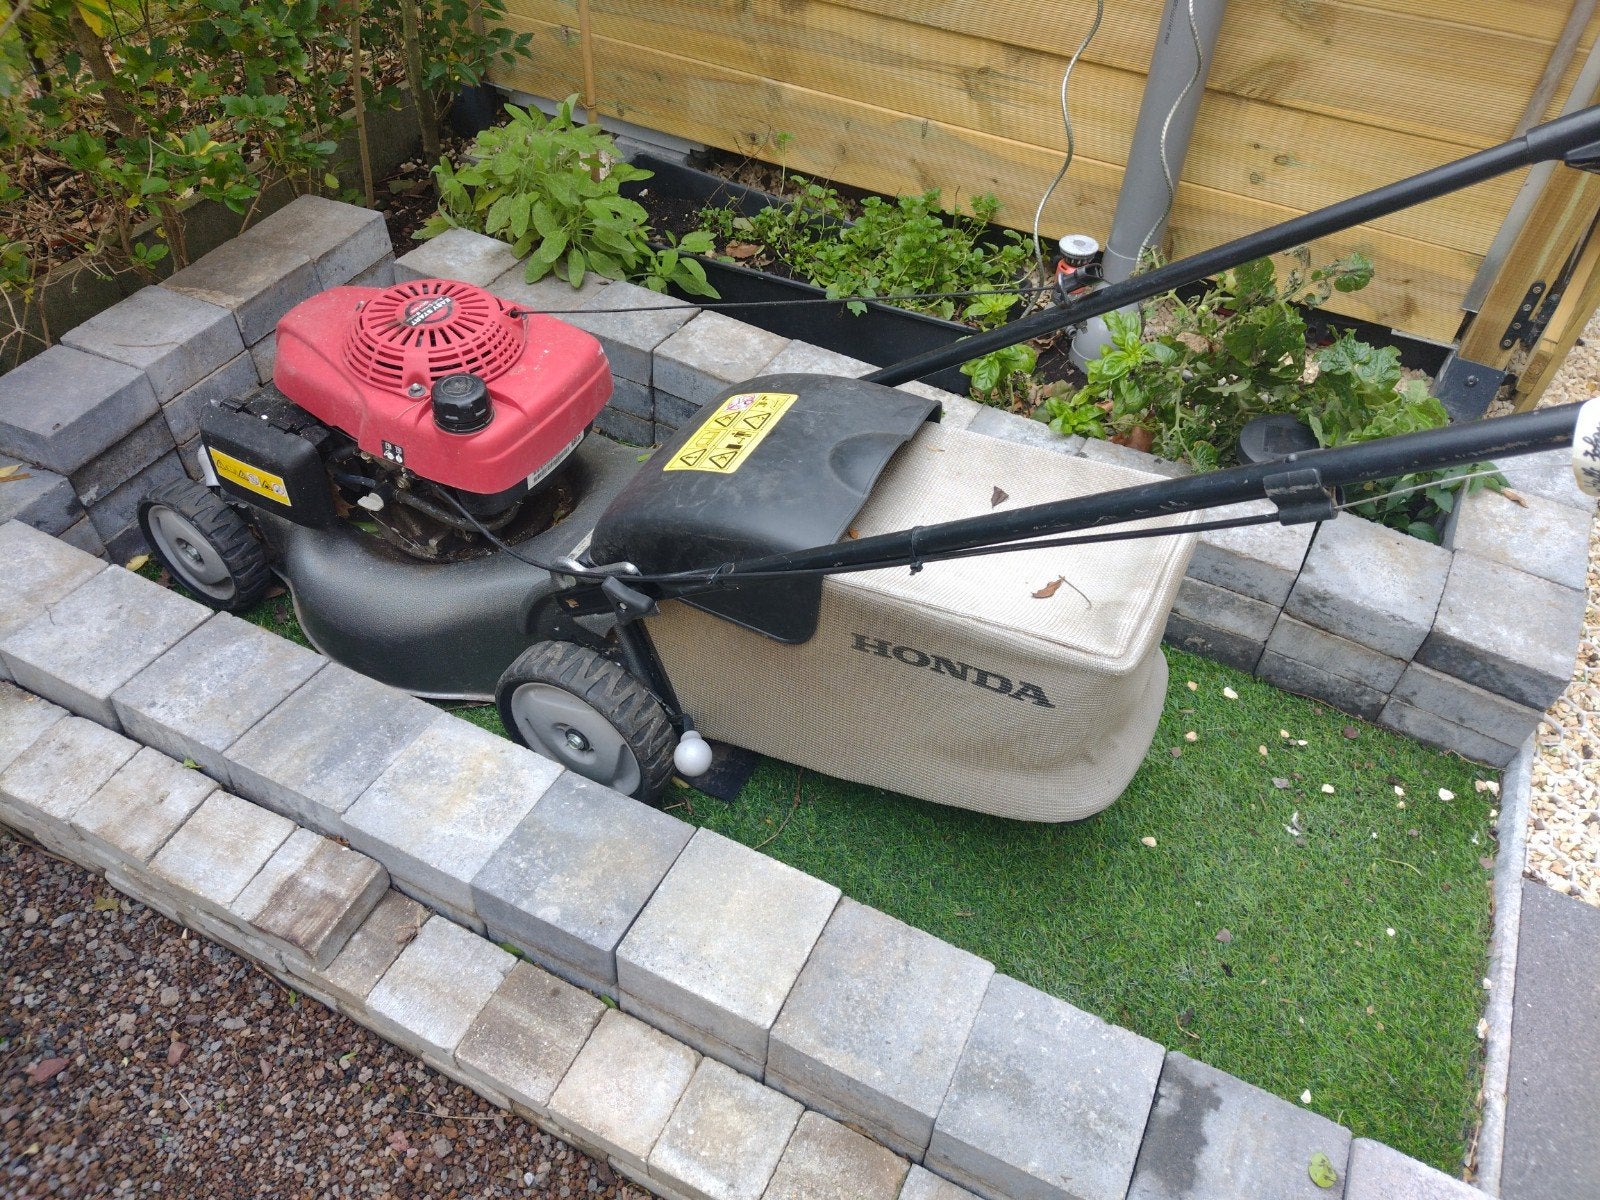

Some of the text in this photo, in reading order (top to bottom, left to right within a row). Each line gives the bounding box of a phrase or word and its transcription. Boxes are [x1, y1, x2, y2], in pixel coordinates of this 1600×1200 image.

[433, 298, 451, 310] EASY
[411, 308, 434, 326] START
[850, 632, 1056, 709] HONDA
